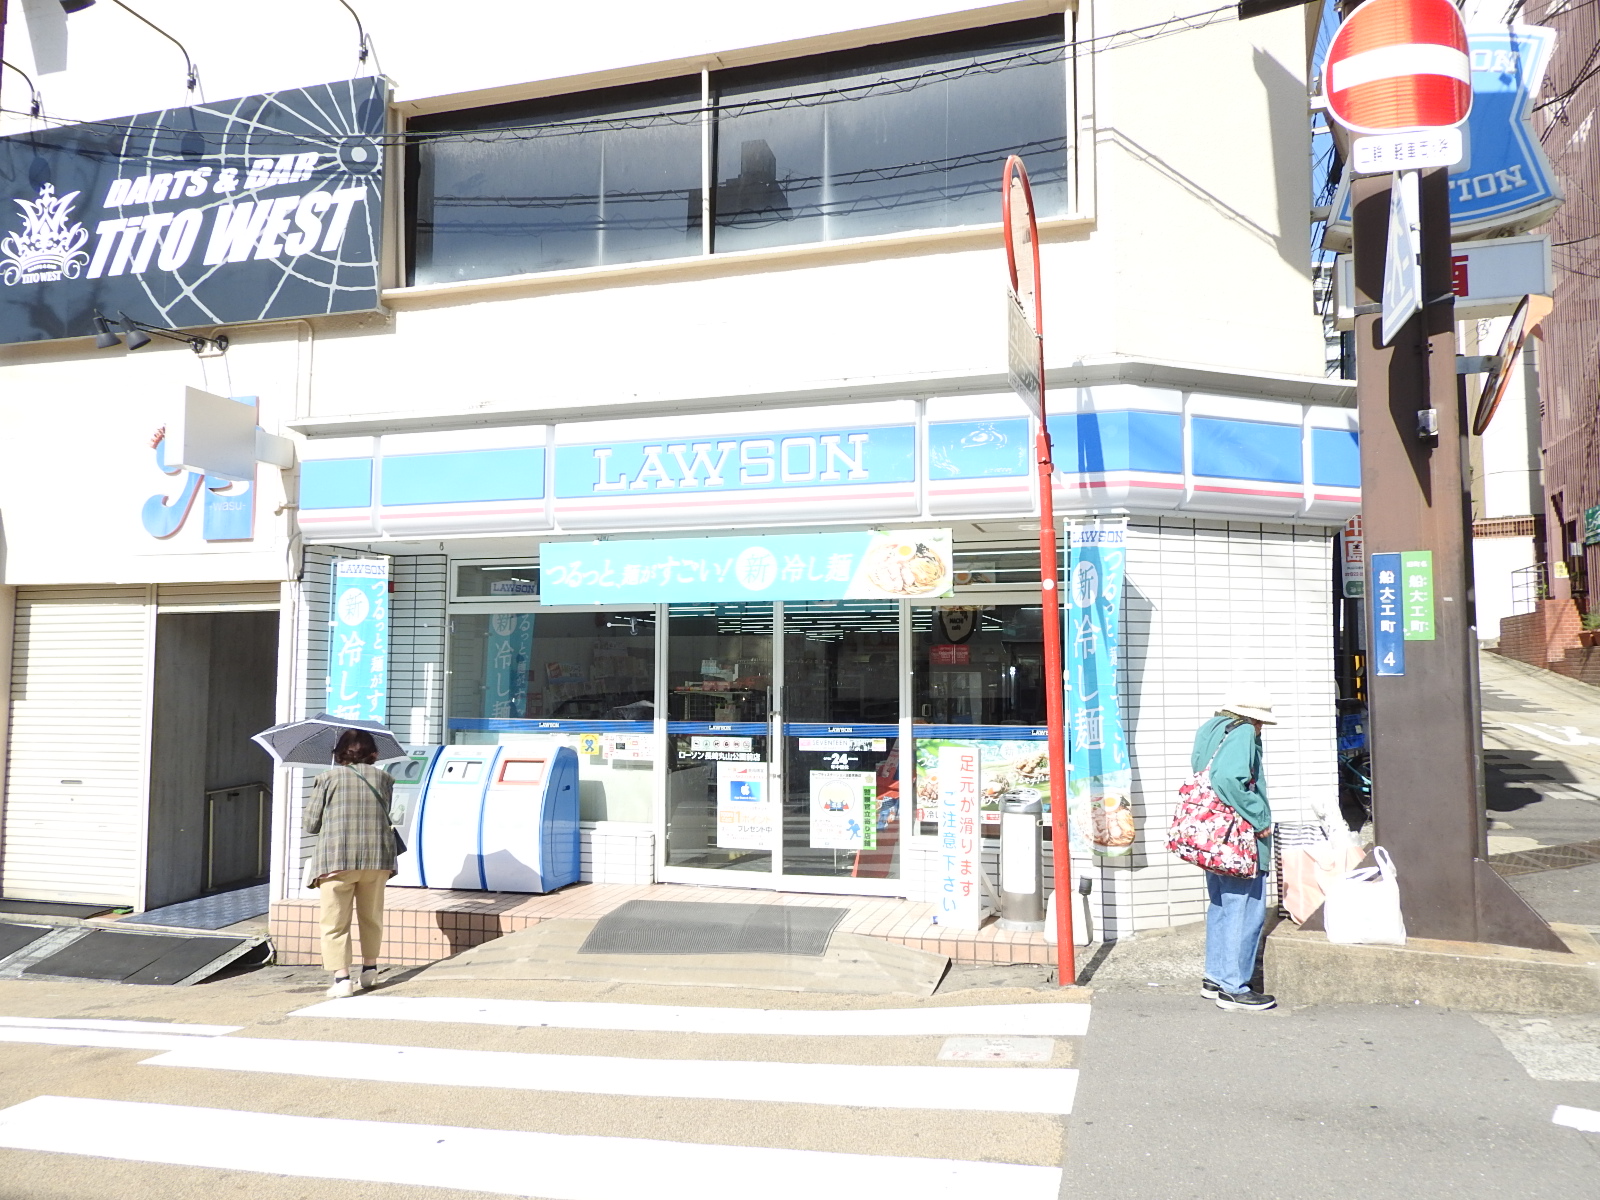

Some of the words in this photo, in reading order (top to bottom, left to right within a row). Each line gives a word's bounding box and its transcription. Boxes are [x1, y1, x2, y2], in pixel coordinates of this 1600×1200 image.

[103, 166, 212, 209] DARTS
[213, 167, 239, 193] &
[243, 152, 320, 190] BAR
[203, 186, 367, 266] WEST
[592, 432, 869, 493] LAWSON
[340, 564, 386, 575] LAWSON
[493, 584, 536, 593] LAWSON
[742, 552, 773, 584] 新
[780, 552, 854, 583] 冷し麺
[344, 592, 362, 620] 新
[1379, 570, 1396, 633] 船大工町
[1409, 575, 1425, 633] 船大工町
[1074, 614, 1106, 753] 冷し麺
[1383, 651, 1396, 667] 4
[831, 752, 848, 765] 24
[942, 791, 957, 912] ご注意下さい
[959, 754, 975, 897] 足元が滑ります
